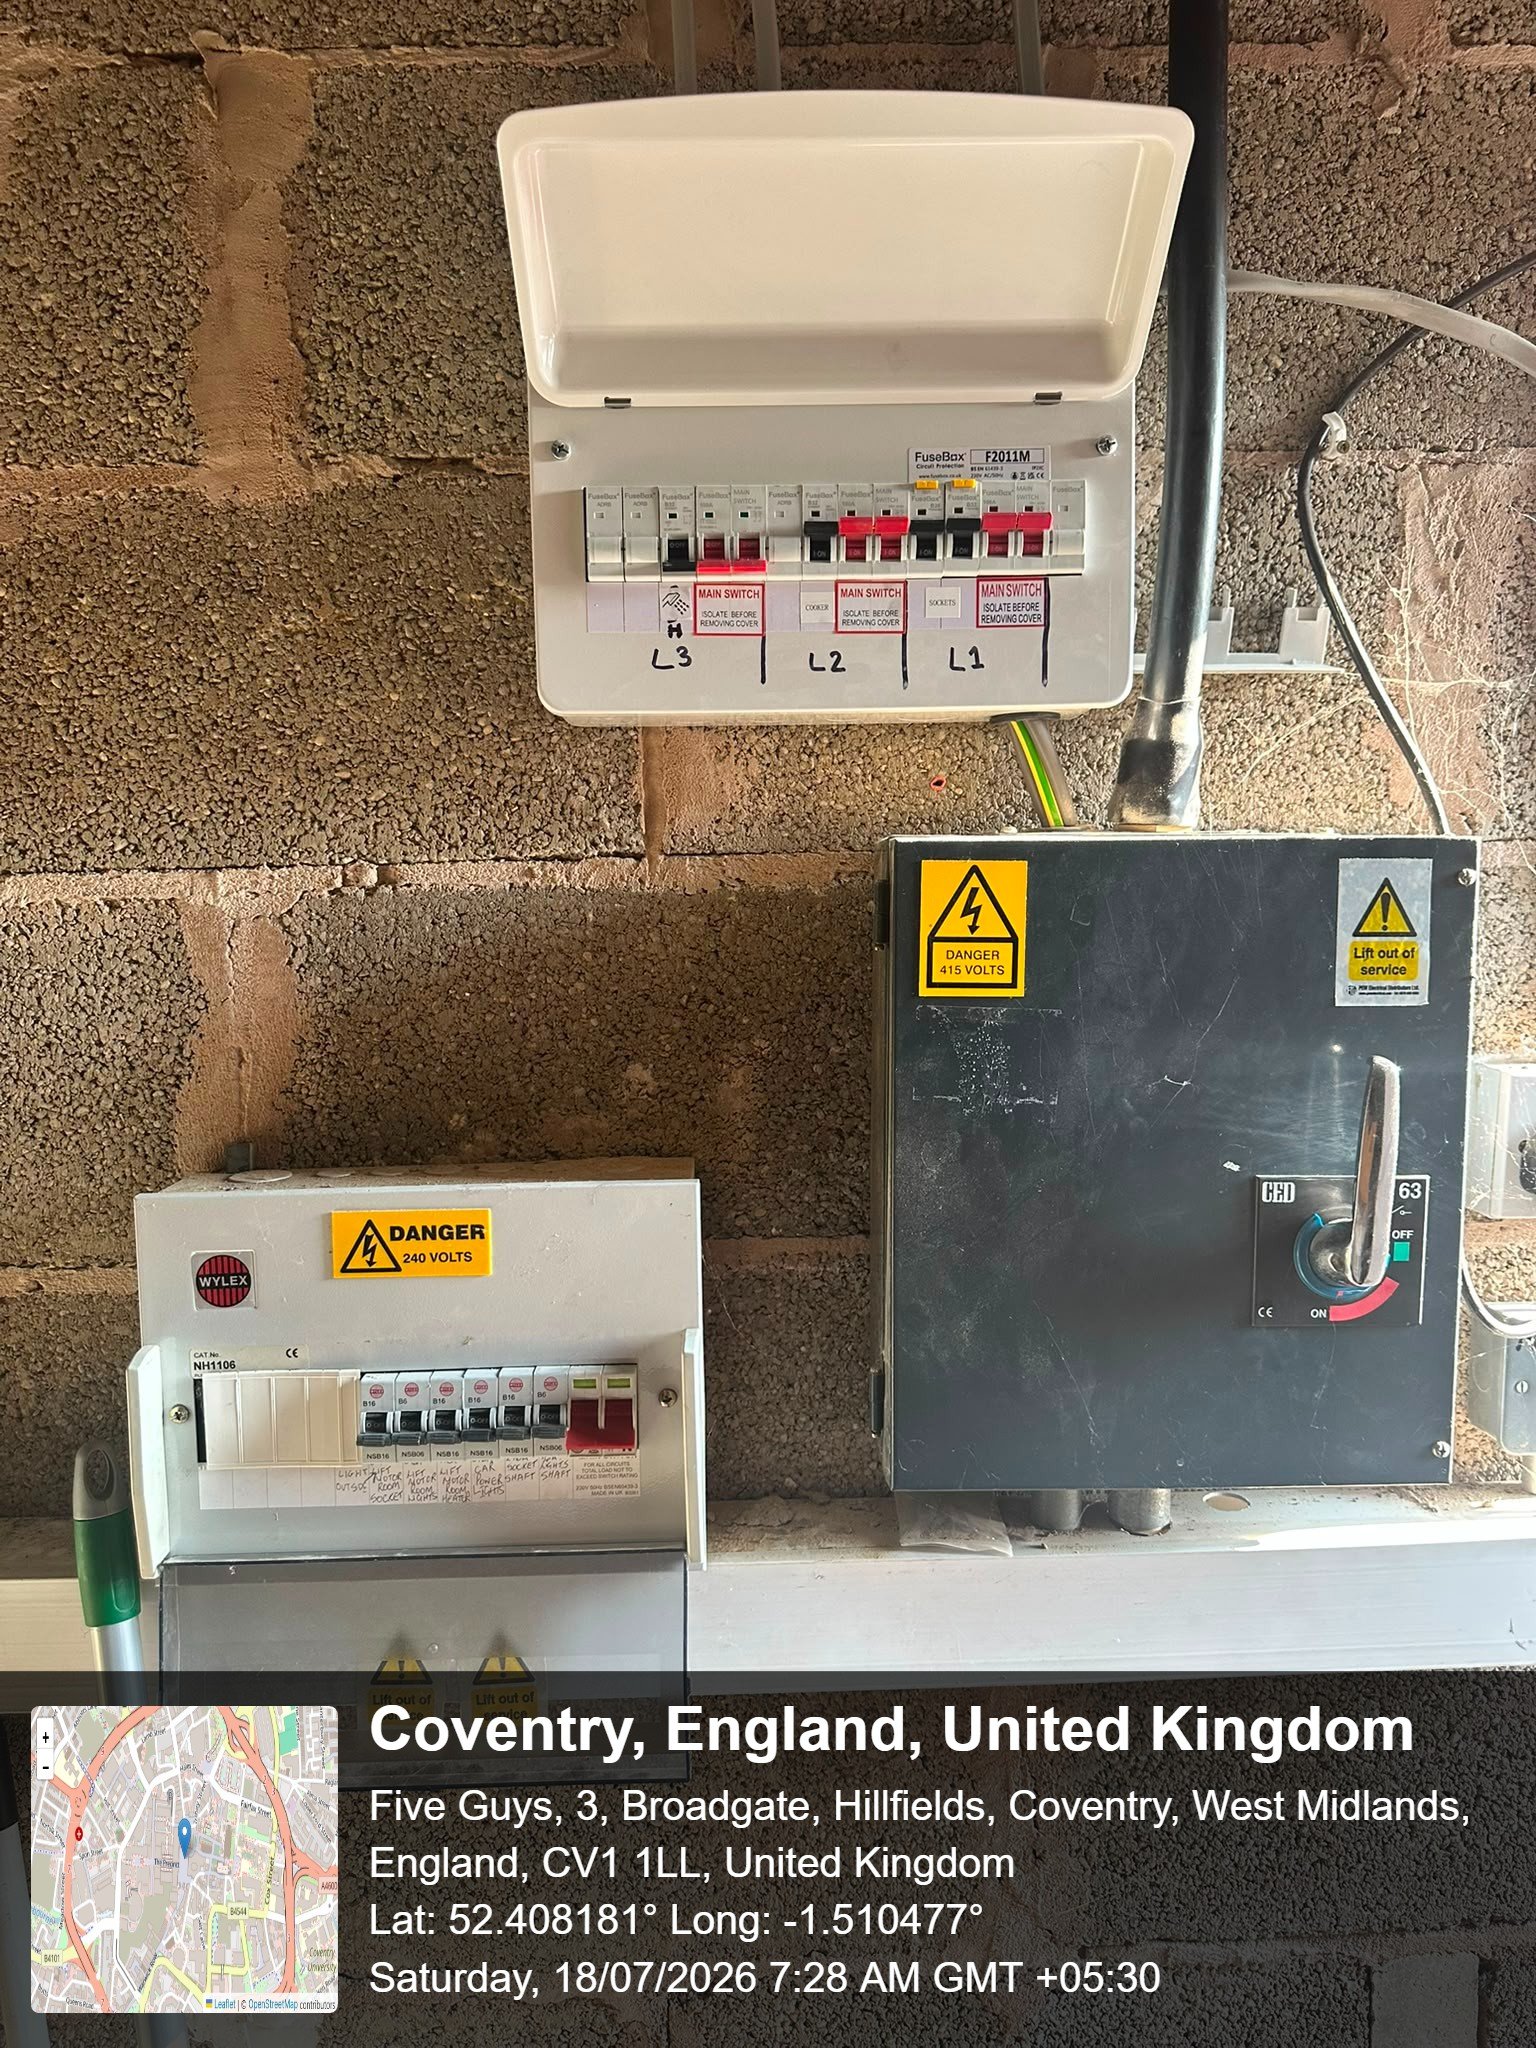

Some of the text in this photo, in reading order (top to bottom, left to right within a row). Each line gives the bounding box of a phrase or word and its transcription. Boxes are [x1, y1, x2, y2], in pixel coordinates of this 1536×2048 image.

[915, 451, 965, 462] FuseBox
[985, 450, 1030, 462] F2011M
[699, 589, 760, 599] MAIN SWITCH
[840, 588, 901, 598] MAIN SWITCH
[981, 583, 1042, 597] MAIN SWITCH
[983, 602, 1040, 612] ISOLATE BEFORE
[843, 609, 898, 617] ISOLATE BEFORE
[981, 613, 1042, 624] REMOVING COVER
[700, 619, 759, 627] REMOVING COVER
[877, 618, 900, 626] COVER
[651, 645, 693, 670] L3
[809, 650, 846, 672] L2
[949, 646, 985, 672] L1
[946, 949, 1000, 960] DANGER
[1354, 947, 1416, 959] Lift out of
[940, 965, 1005, 975] 415 VOLTS
[1360, 964, 1407, 975] service
[1398, 1182, 1422, 1200] 63
[389, 1224, 485, 1242] DANGER
[1391, 1230, 1414, 1239] OFF
[403, 1251, 473, 1264] 240 VOLTS
[199, 1275, 249, 1288] WYLEX
[1310, 1309, 1327, 1318] ON
[193, 1360, 236, 1371] NH1106
[474, 1460, 496, 1474] CAR
[338, 1468, 368, 1478] LIGHT
[504, 1472, 536, 1483] SHAFT
[540, 1469, 571, 1481] SHAFT
[476, 1472, 503, 1486] POWER
[372, 1694, 431, 1706] Lift out of
[476, 1691, 535, 1706] Lift out of
